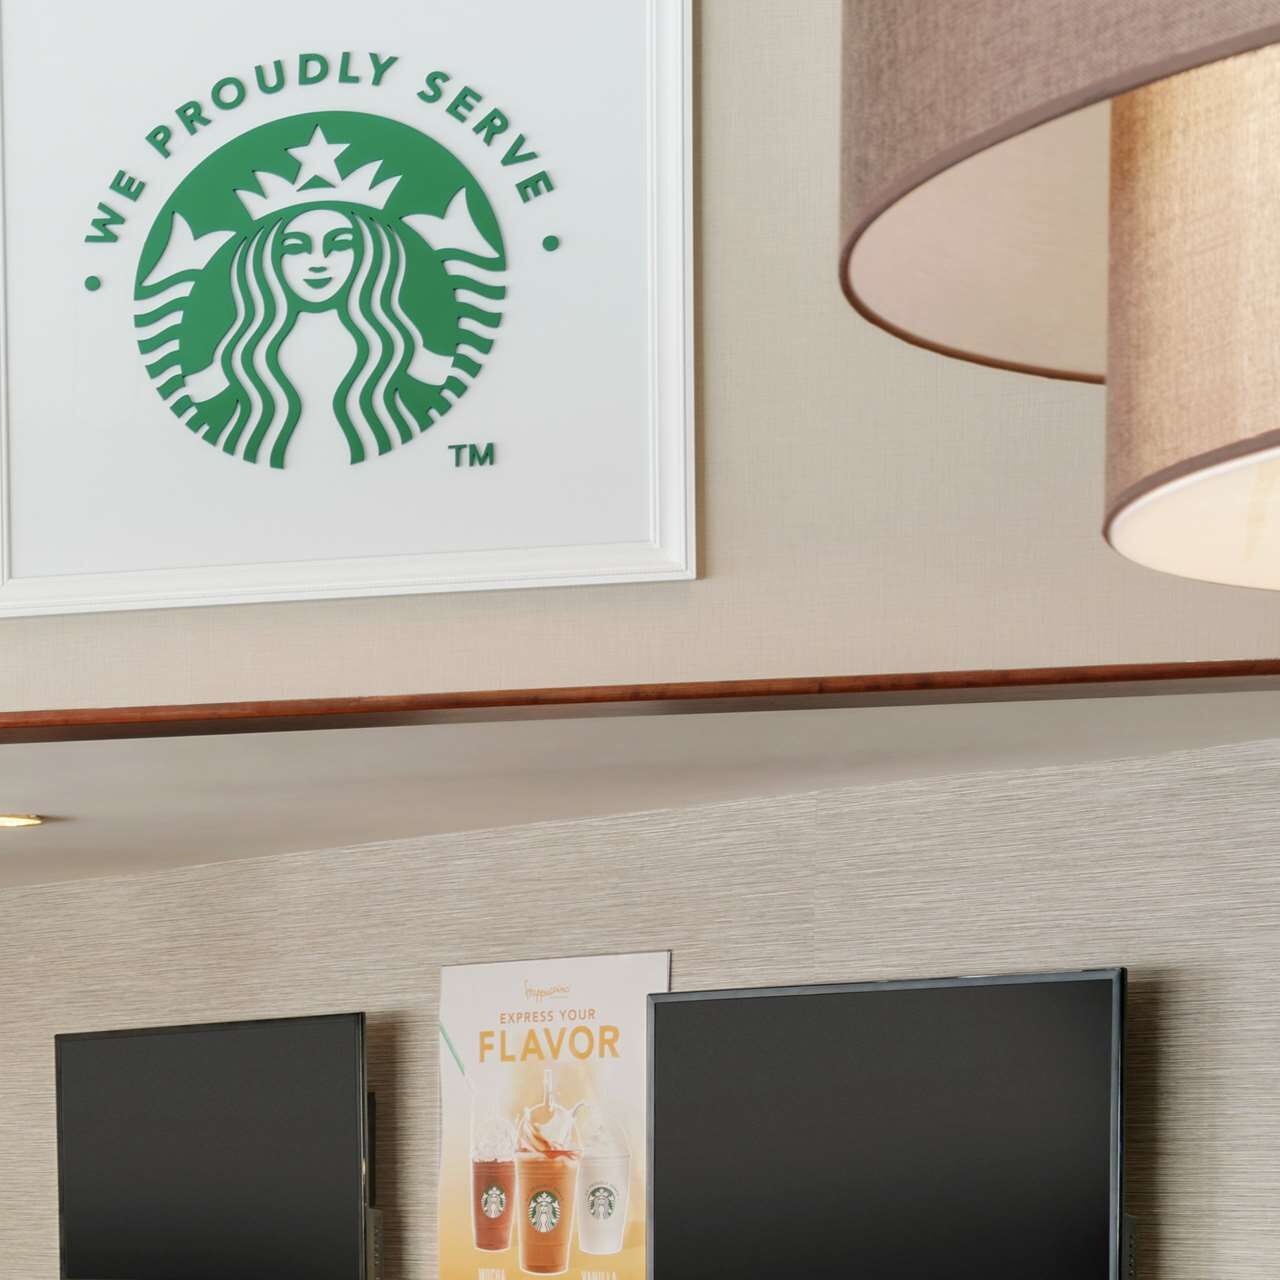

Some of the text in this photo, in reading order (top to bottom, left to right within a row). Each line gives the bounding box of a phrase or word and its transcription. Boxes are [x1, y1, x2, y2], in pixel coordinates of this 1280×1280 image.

[85, 52, 554, 243] WE PROUDLY SERVE
[448, 442, 495, 467] TM
[500, 1008, 596, 1024] EXPRESS YOUR
[479, 1025, 621, 1063] FLAVOR
